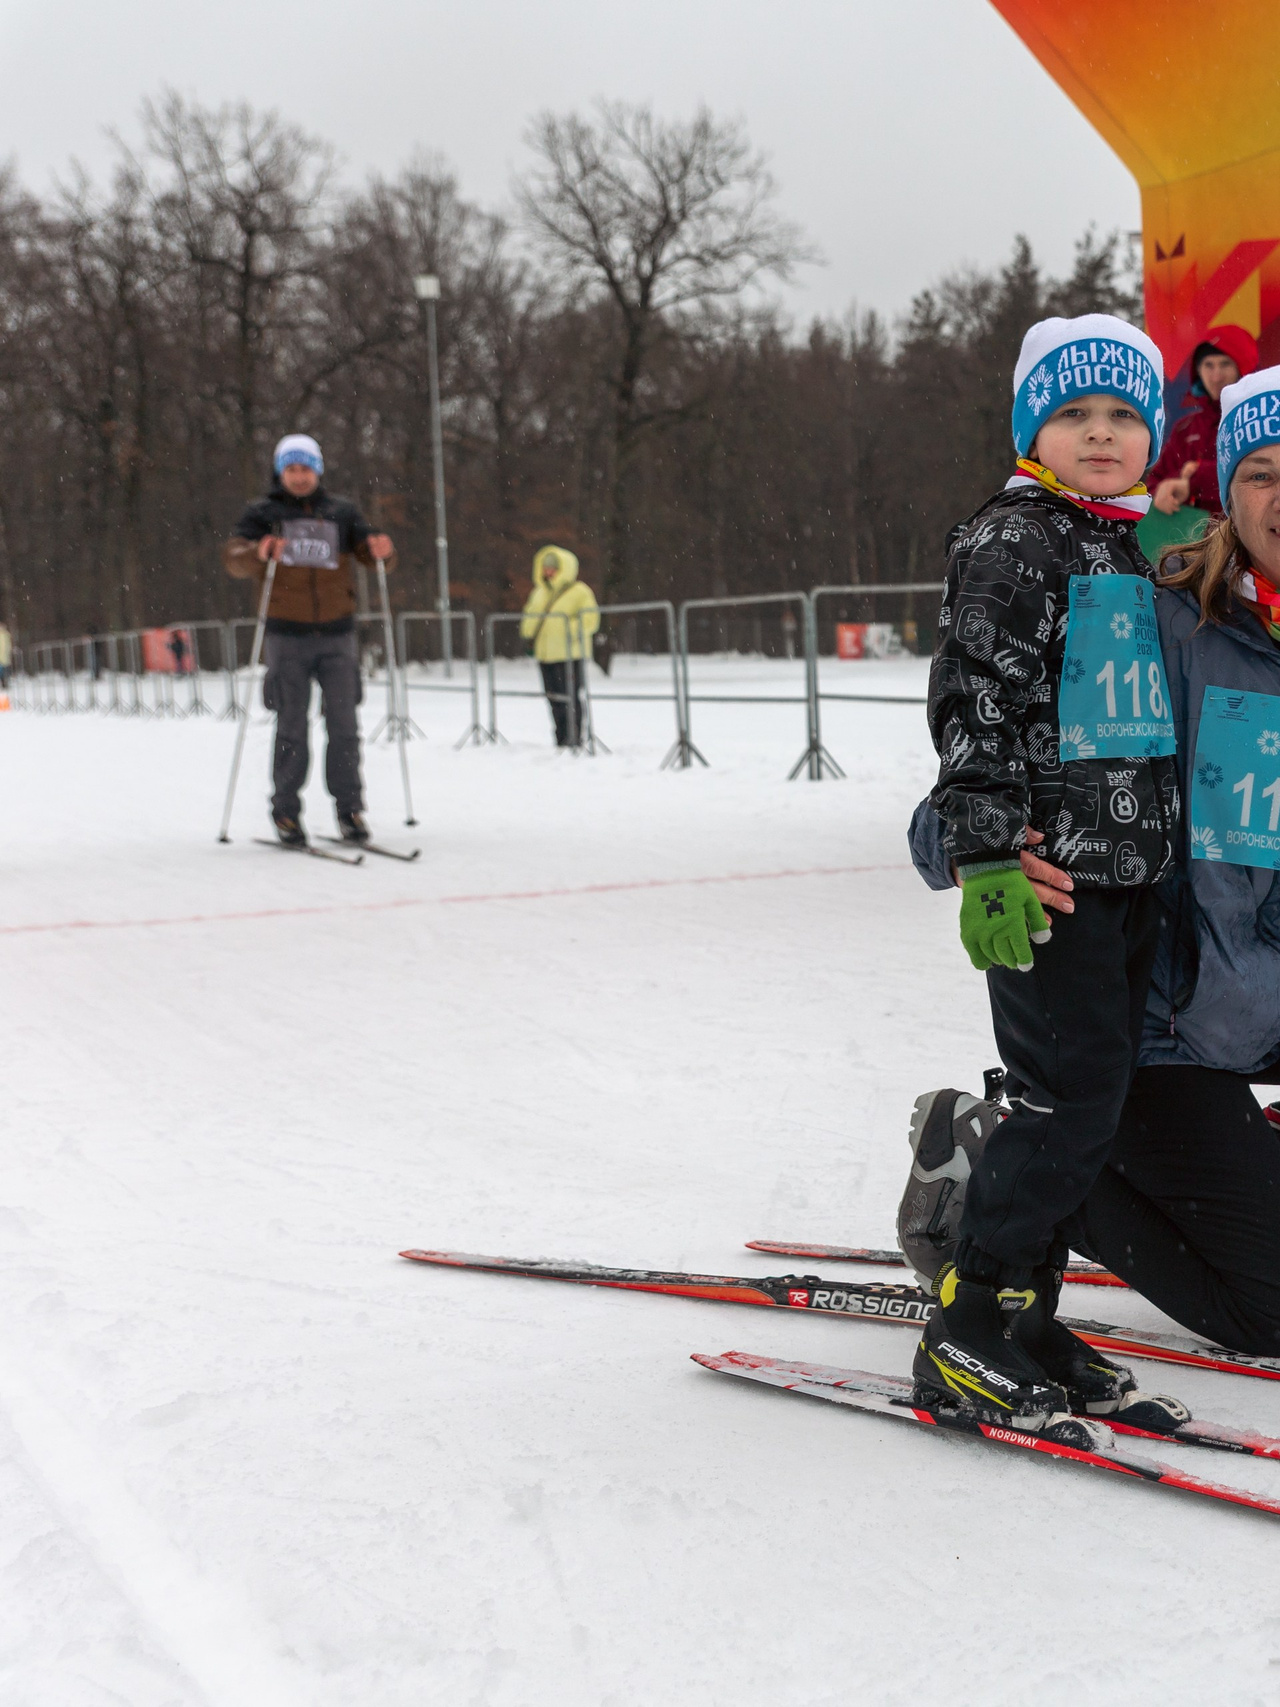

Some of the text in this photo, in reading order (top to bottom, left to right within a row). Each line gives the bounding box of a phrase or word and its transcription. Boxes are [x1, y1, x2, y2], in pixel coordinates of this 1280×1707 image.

[1057, 341, 1151, 386] ЛЫЖНЯ
[1058, 363, 1150, 408] РОССИИ
[1096, 660, 1168, 720] 118
[811, 1290, 937, 1321] ROSSIGNO
[937, 1341, 1020, 1393] FISCHER
[989, 1427, 1039, 1448] NORDWAY
